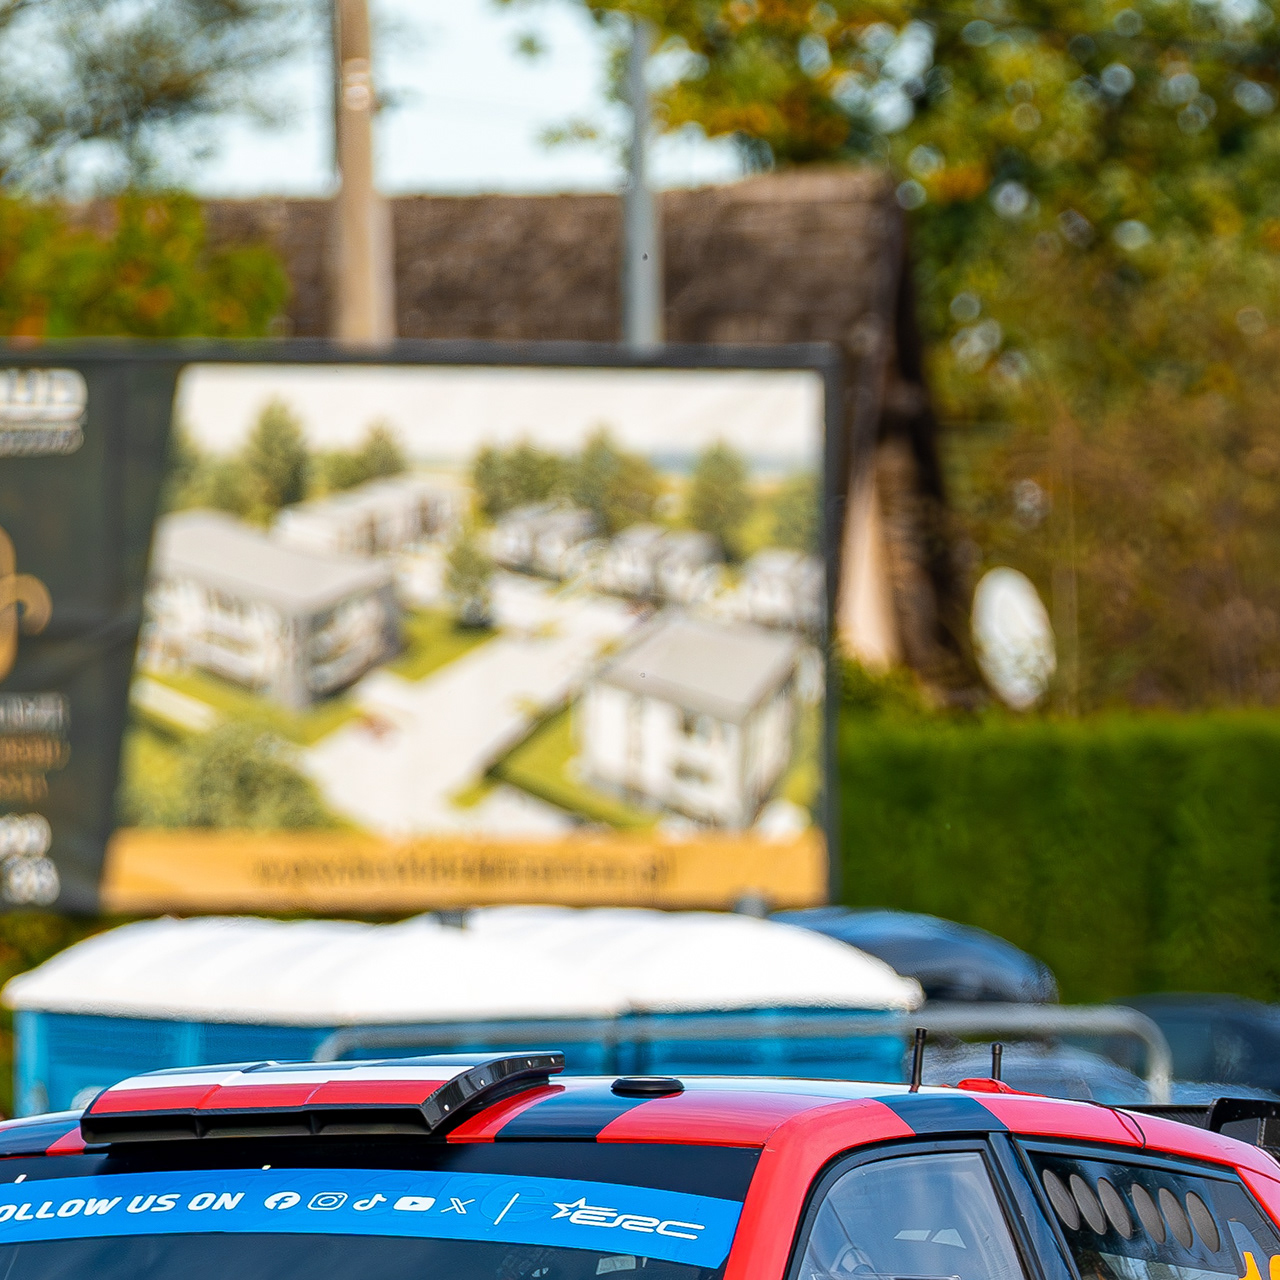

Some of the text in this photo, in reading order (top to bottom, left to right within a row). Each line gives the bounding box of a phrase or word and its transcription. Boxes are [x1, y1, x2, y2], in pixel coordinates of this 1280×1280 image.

[127, 1193, 181, 1214] US
[187, 1191, 245, 1211] ON
[554, 1198, 706, 1241] ERC
